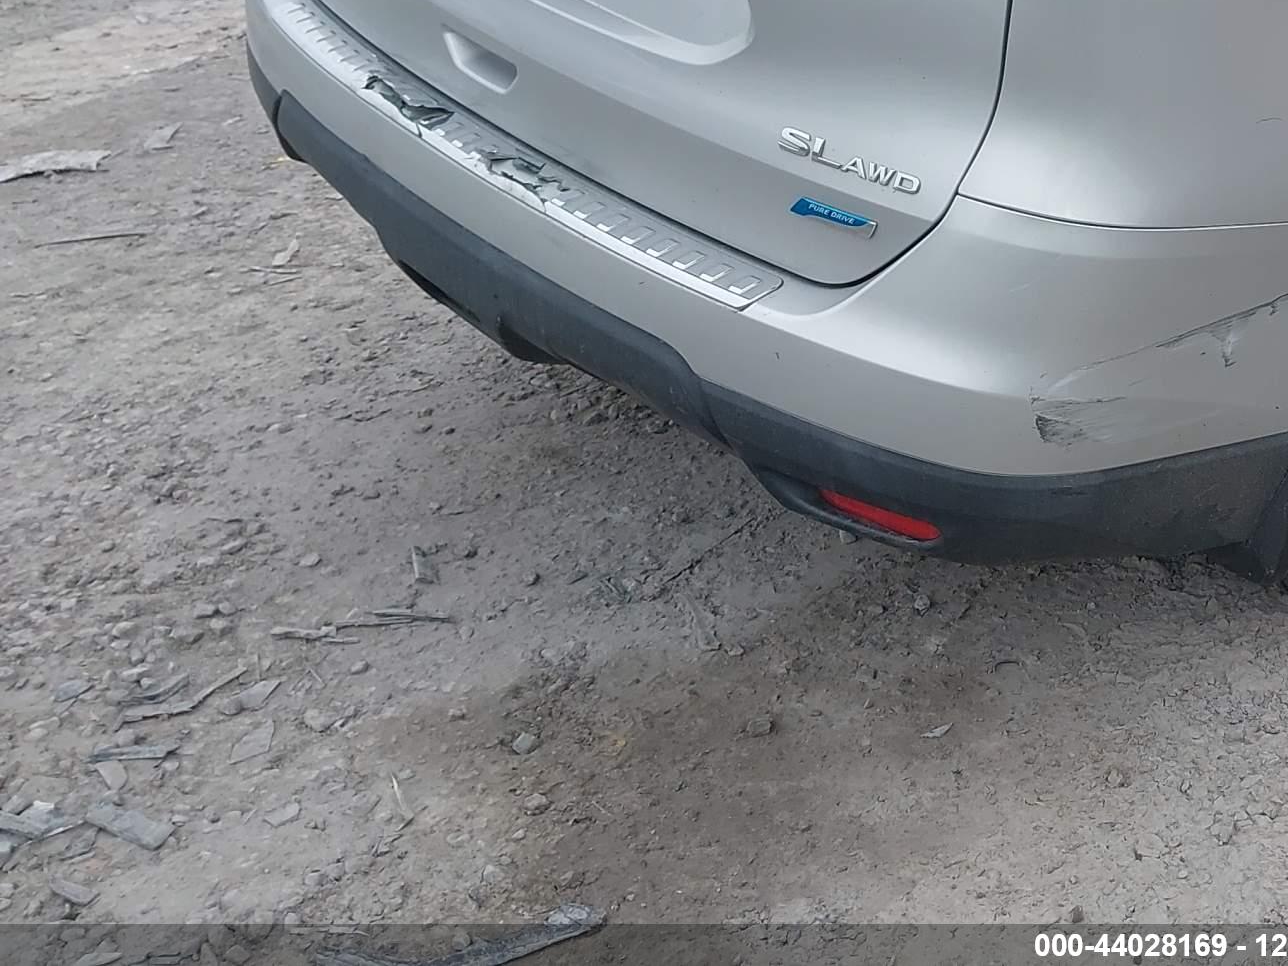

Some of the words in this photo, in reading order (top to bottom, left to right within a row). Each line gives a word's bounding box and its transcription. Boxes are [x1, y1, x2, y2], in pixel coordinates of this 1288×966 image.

[777, 126, 841, 170] SL
[840, 155, 922, 195] AWD
[808, 203, 829, 216] PURE
[830, 211, 856, 225] DRIVE
